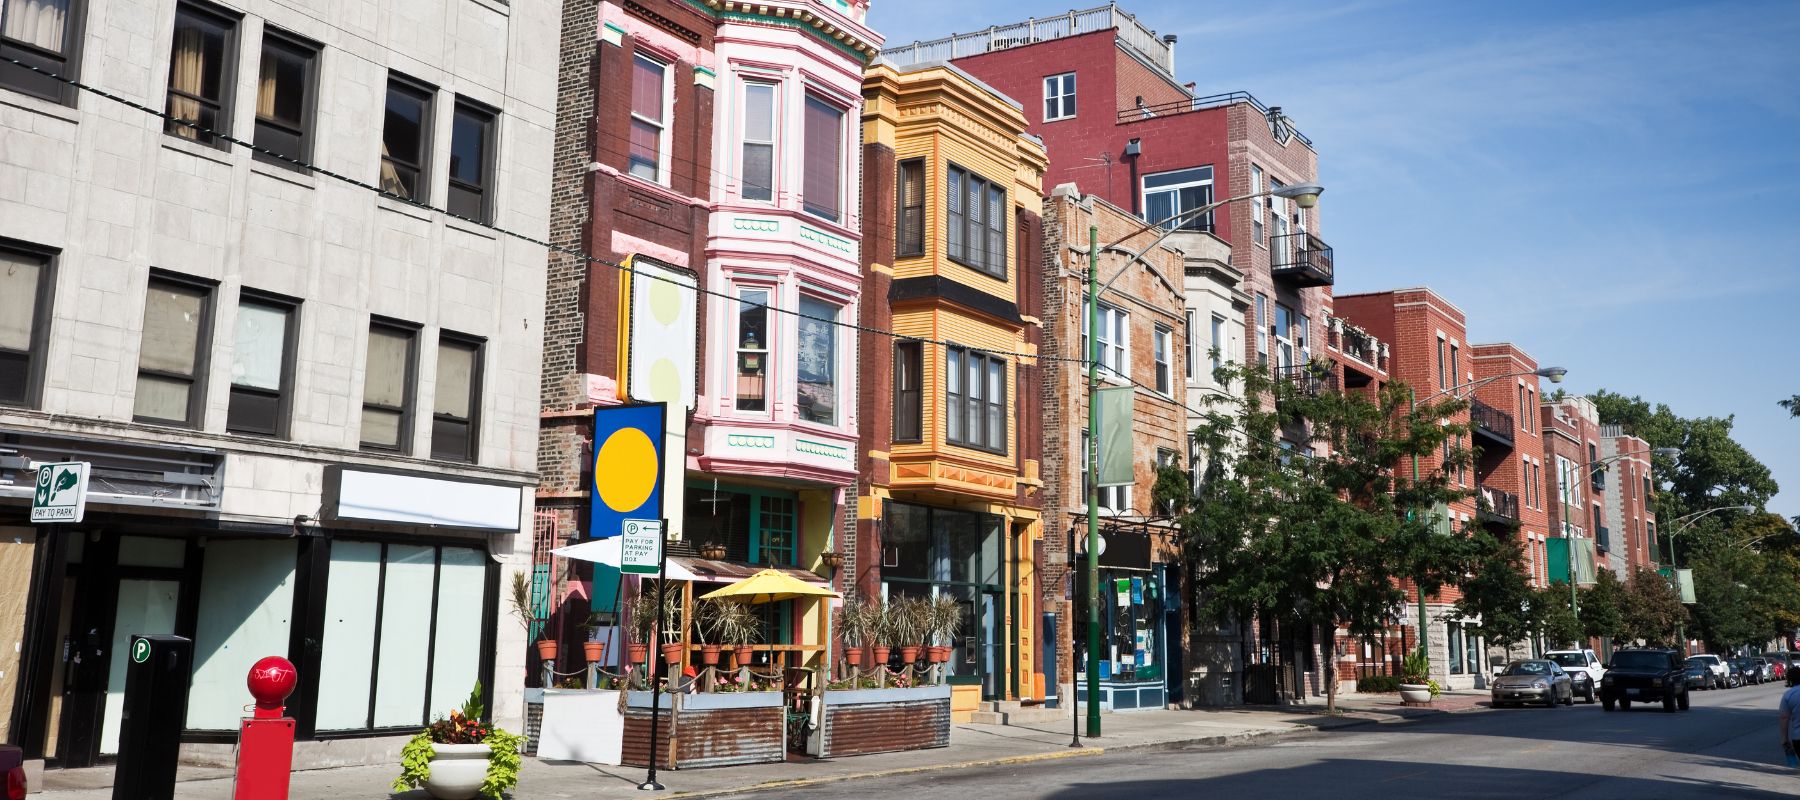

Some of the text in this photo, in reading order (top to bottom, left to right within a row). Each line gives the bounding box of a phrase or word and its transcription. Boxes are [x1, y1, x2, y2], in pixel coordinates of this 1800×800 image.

[34, 508, 73, 517] PAY TO PARK
[136, 642, 146, 658] P
